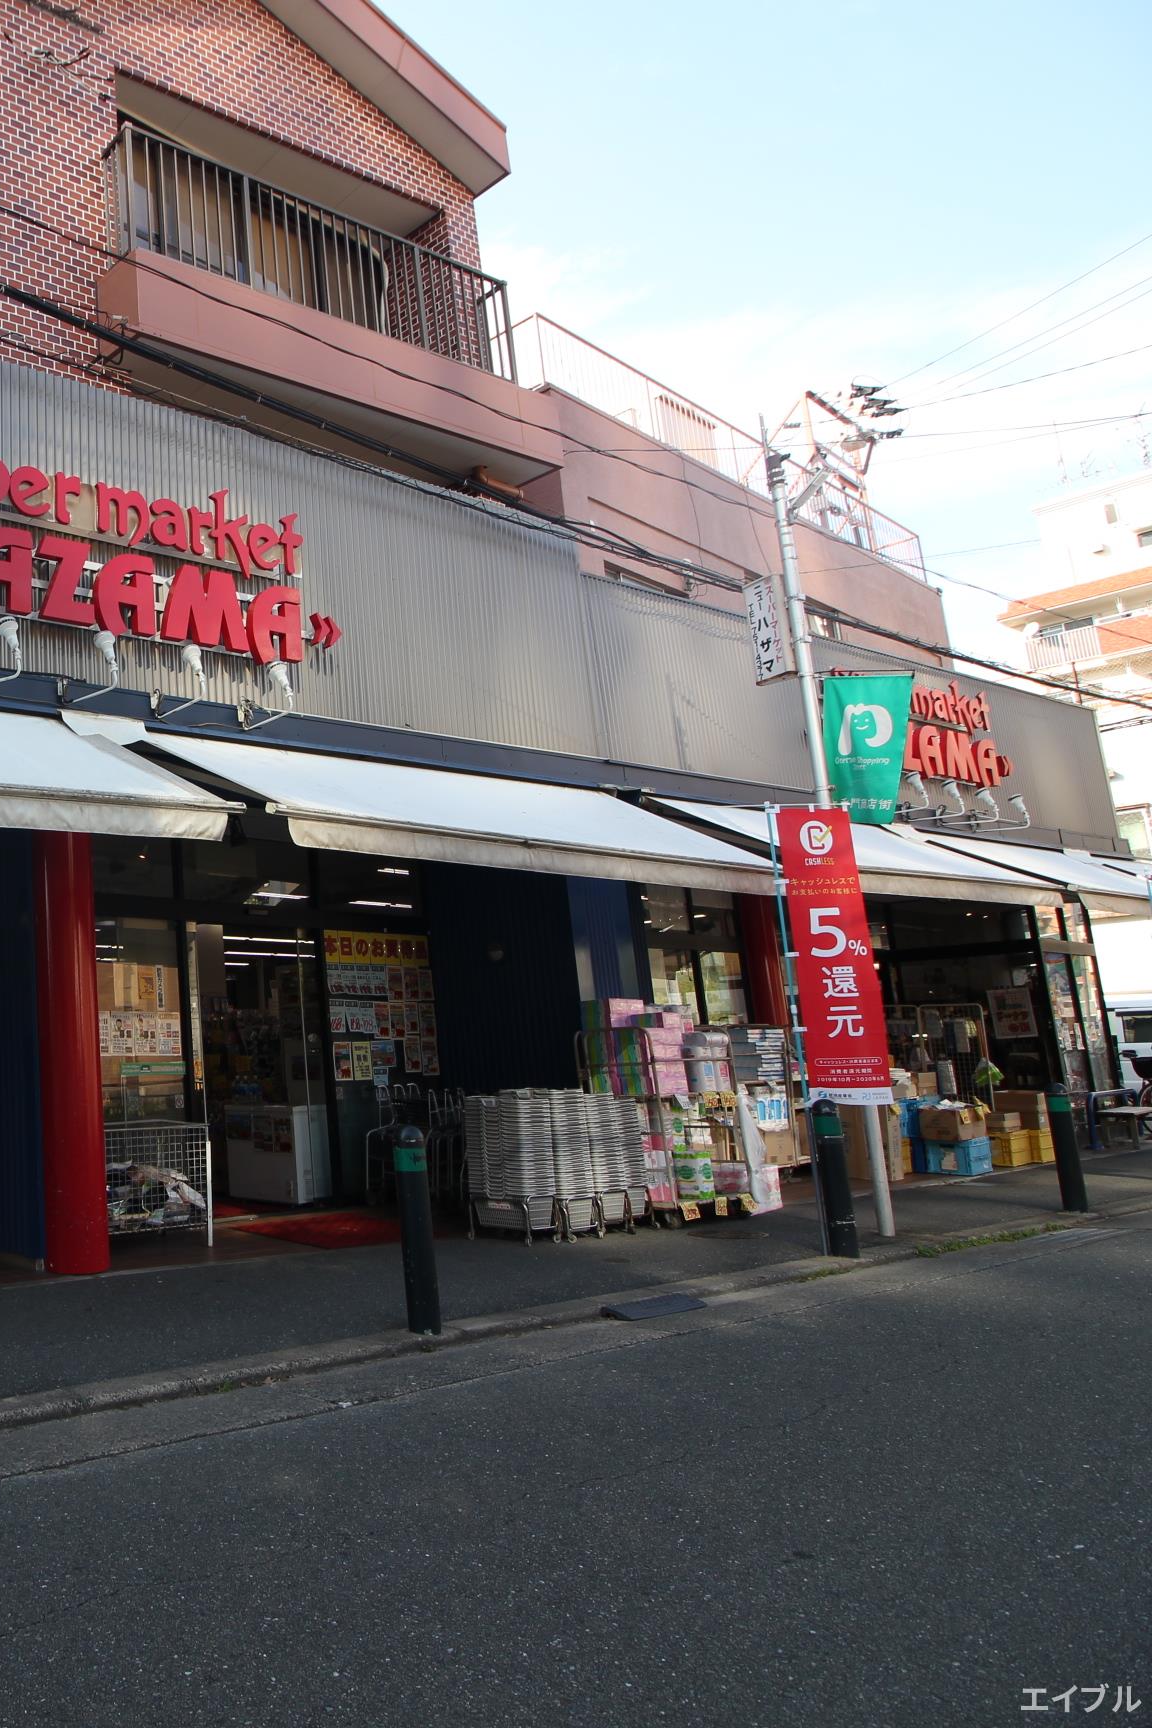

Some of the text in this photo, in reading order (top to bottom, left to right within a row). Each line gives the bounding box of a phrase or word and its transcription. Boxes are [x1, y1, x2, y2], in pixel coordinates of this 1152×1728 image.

[96, 482, 304, 579] market
[910, 679, 991, 736] market
[804, 858, 835, 866] CASHLESS
[790, 877, 856, 886] キャッシュレスで
